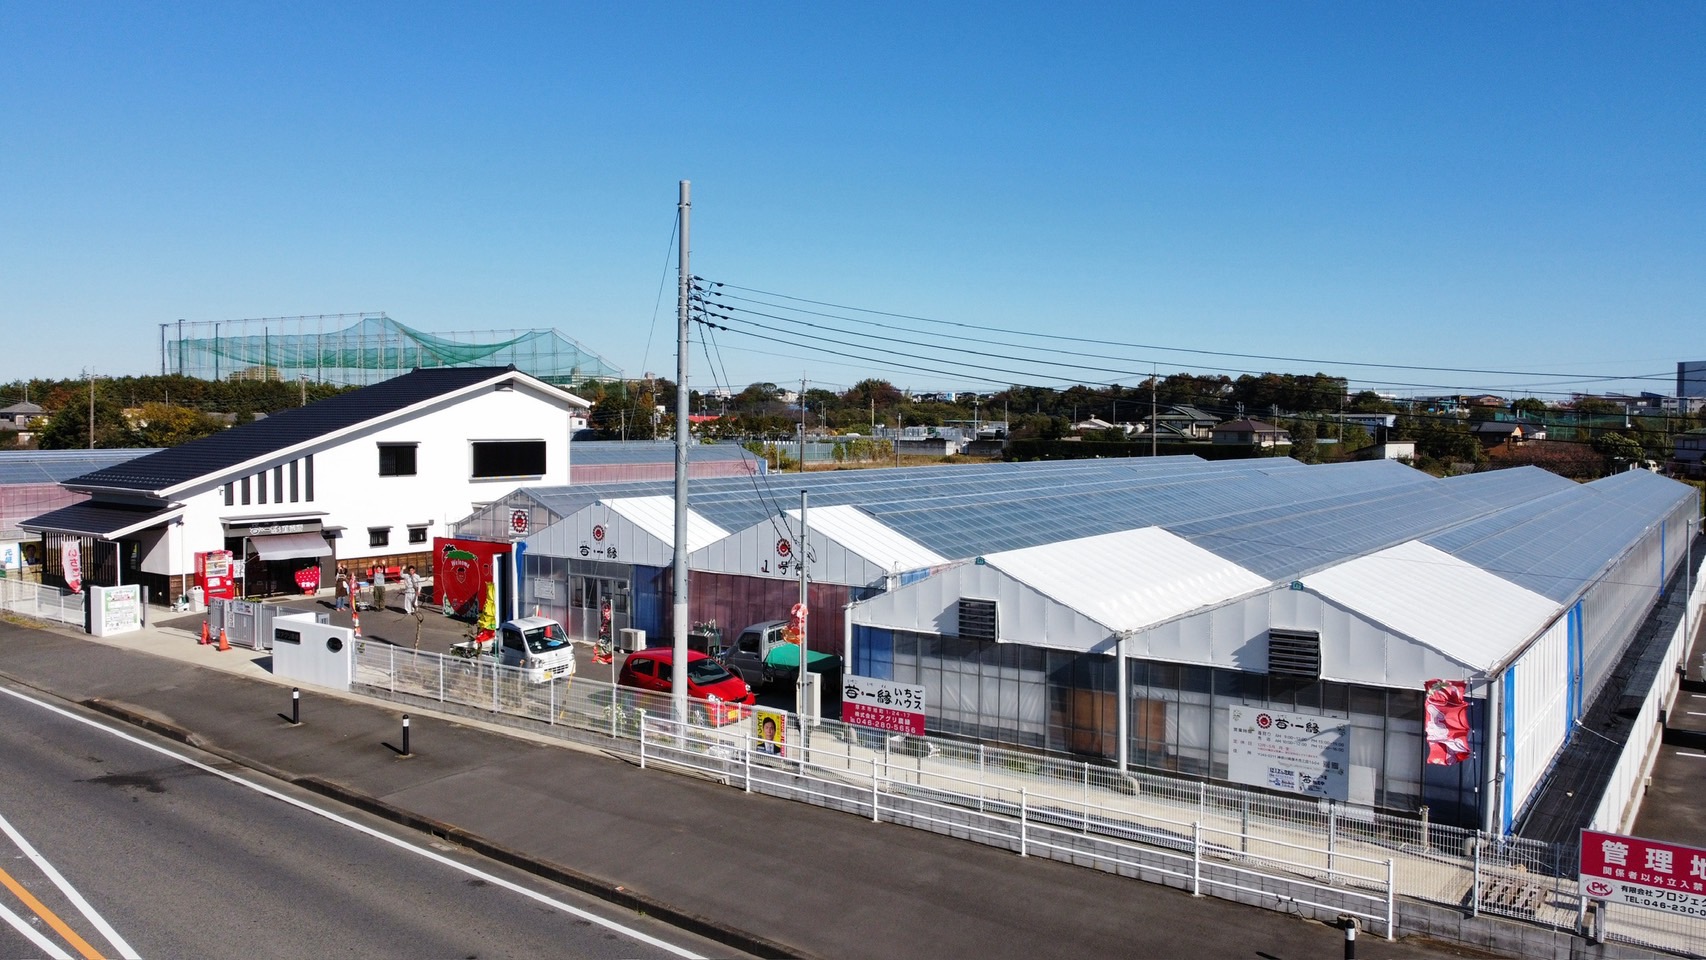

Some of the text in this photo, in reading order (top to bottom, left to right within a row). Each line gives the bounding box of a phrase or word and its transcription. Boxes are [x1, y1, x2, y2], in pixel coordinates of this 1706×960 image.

[894, 688, 922, 700] いちご
[894, 699, 922, 710] ハウス
[855, 711, 876, 720] 株式会社
[1602, 840, 1706, 880] 管理地
[1602, 866, 1703, 891] 関係者以外立入禁
[1592, 881, 1608, 893] PK
[1621, 885, 1653, 898] 有限会社
